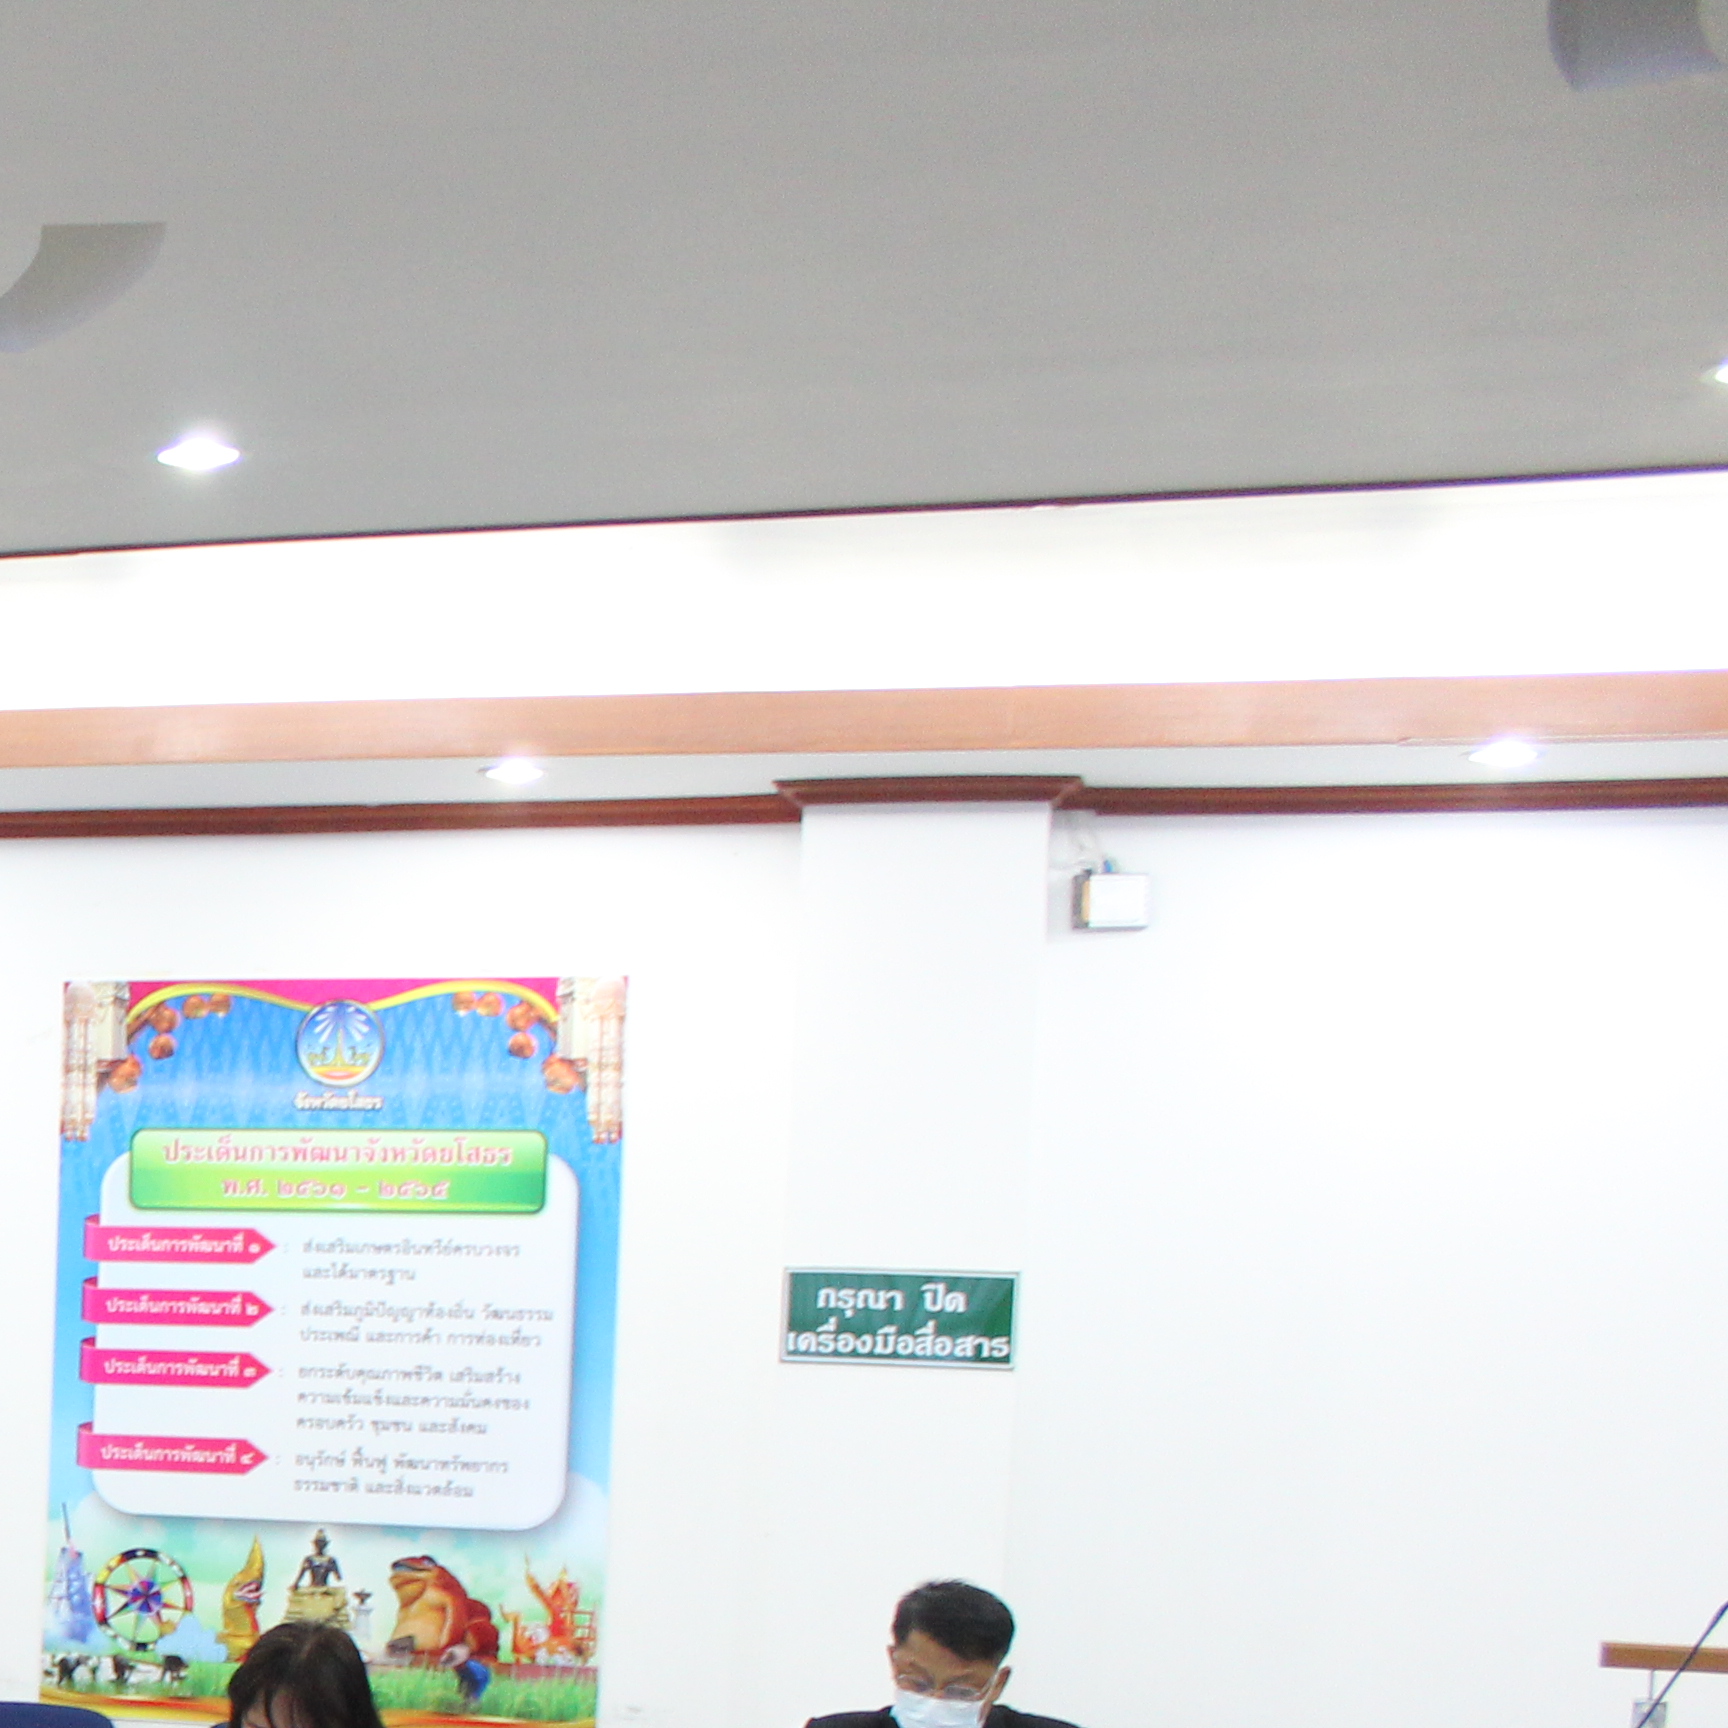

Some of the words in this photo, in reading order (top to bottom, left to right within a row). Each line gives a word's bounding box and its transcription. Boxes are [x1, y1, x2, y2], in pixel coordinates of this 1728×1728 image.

[163, 1135, 513, 1166] ประเด็นการพัฒนาจังหวัดยโสธร
[221, 1177, 269, 1198] พ.ศ.
[107, 1232, 244, 1253] ประเด็นการพัฒนาที่
[105, 1294, 242, 1315] ประเด็นการพัฒนาที่
[816, 1285, 904, 1318] กรุณา
[920, 1282, 968, 1314] ปิด
[786, 1316, 1010, 1358] เครื่องมือสื่อสาร
[103, 1355, 240, 1377] ประเด็นการพัฒนาที่
[100, 1442, 237, 1464] ประเด็นการพัฒนาที่
